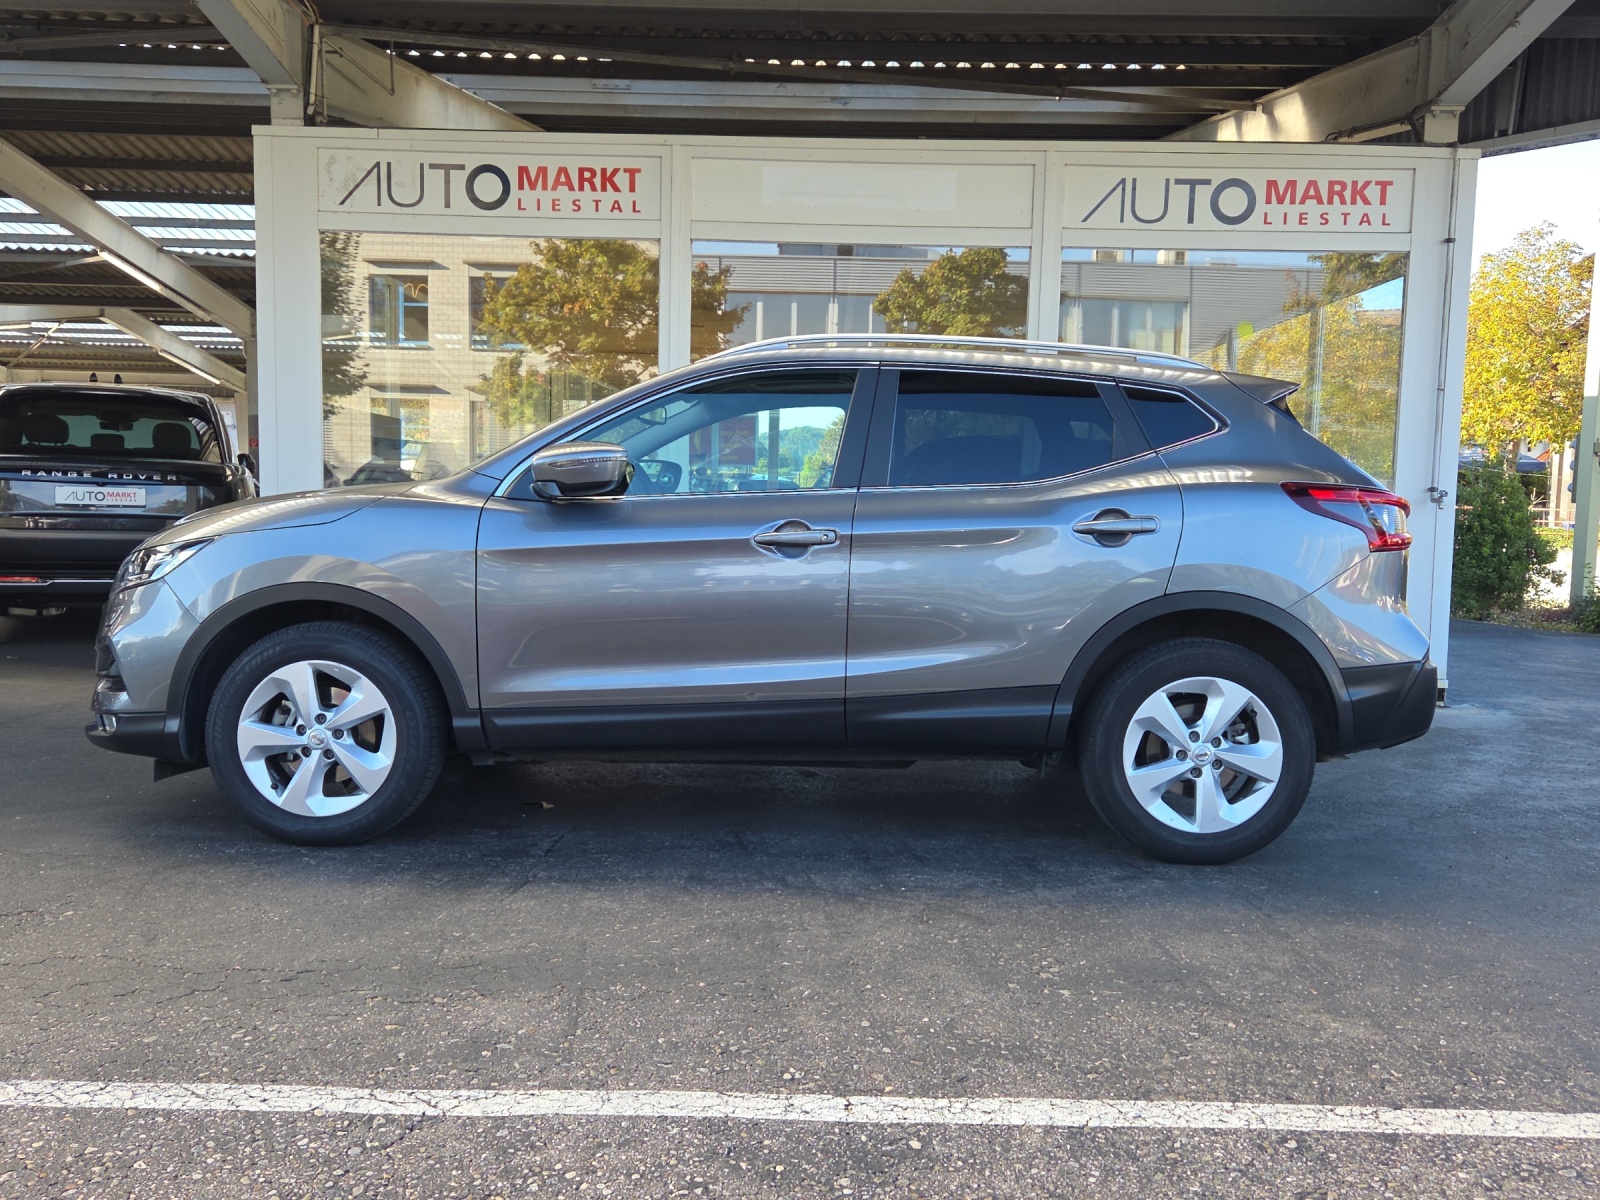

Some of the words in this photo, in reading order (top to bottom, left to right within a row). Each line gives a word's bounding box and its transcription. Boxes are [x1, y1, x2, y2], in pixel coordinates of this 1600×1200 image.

[338, 161, 511, 211] AUTO
[517, 165, 642, 194] MARKT
[517, 197, 642, 214] LIESTAL
[1080, 177, 1257, 225] AUTO
[1265, 179, 1394, 206] MARKT
[1263, 211, 1391, 226] LIESTAL
[22, 469, 92, 478] RANGE
[108, 473, 177, 481] ROVER
[65, 491, 106, 502] AUTO
[106, 491, 137, 499] MARKT
